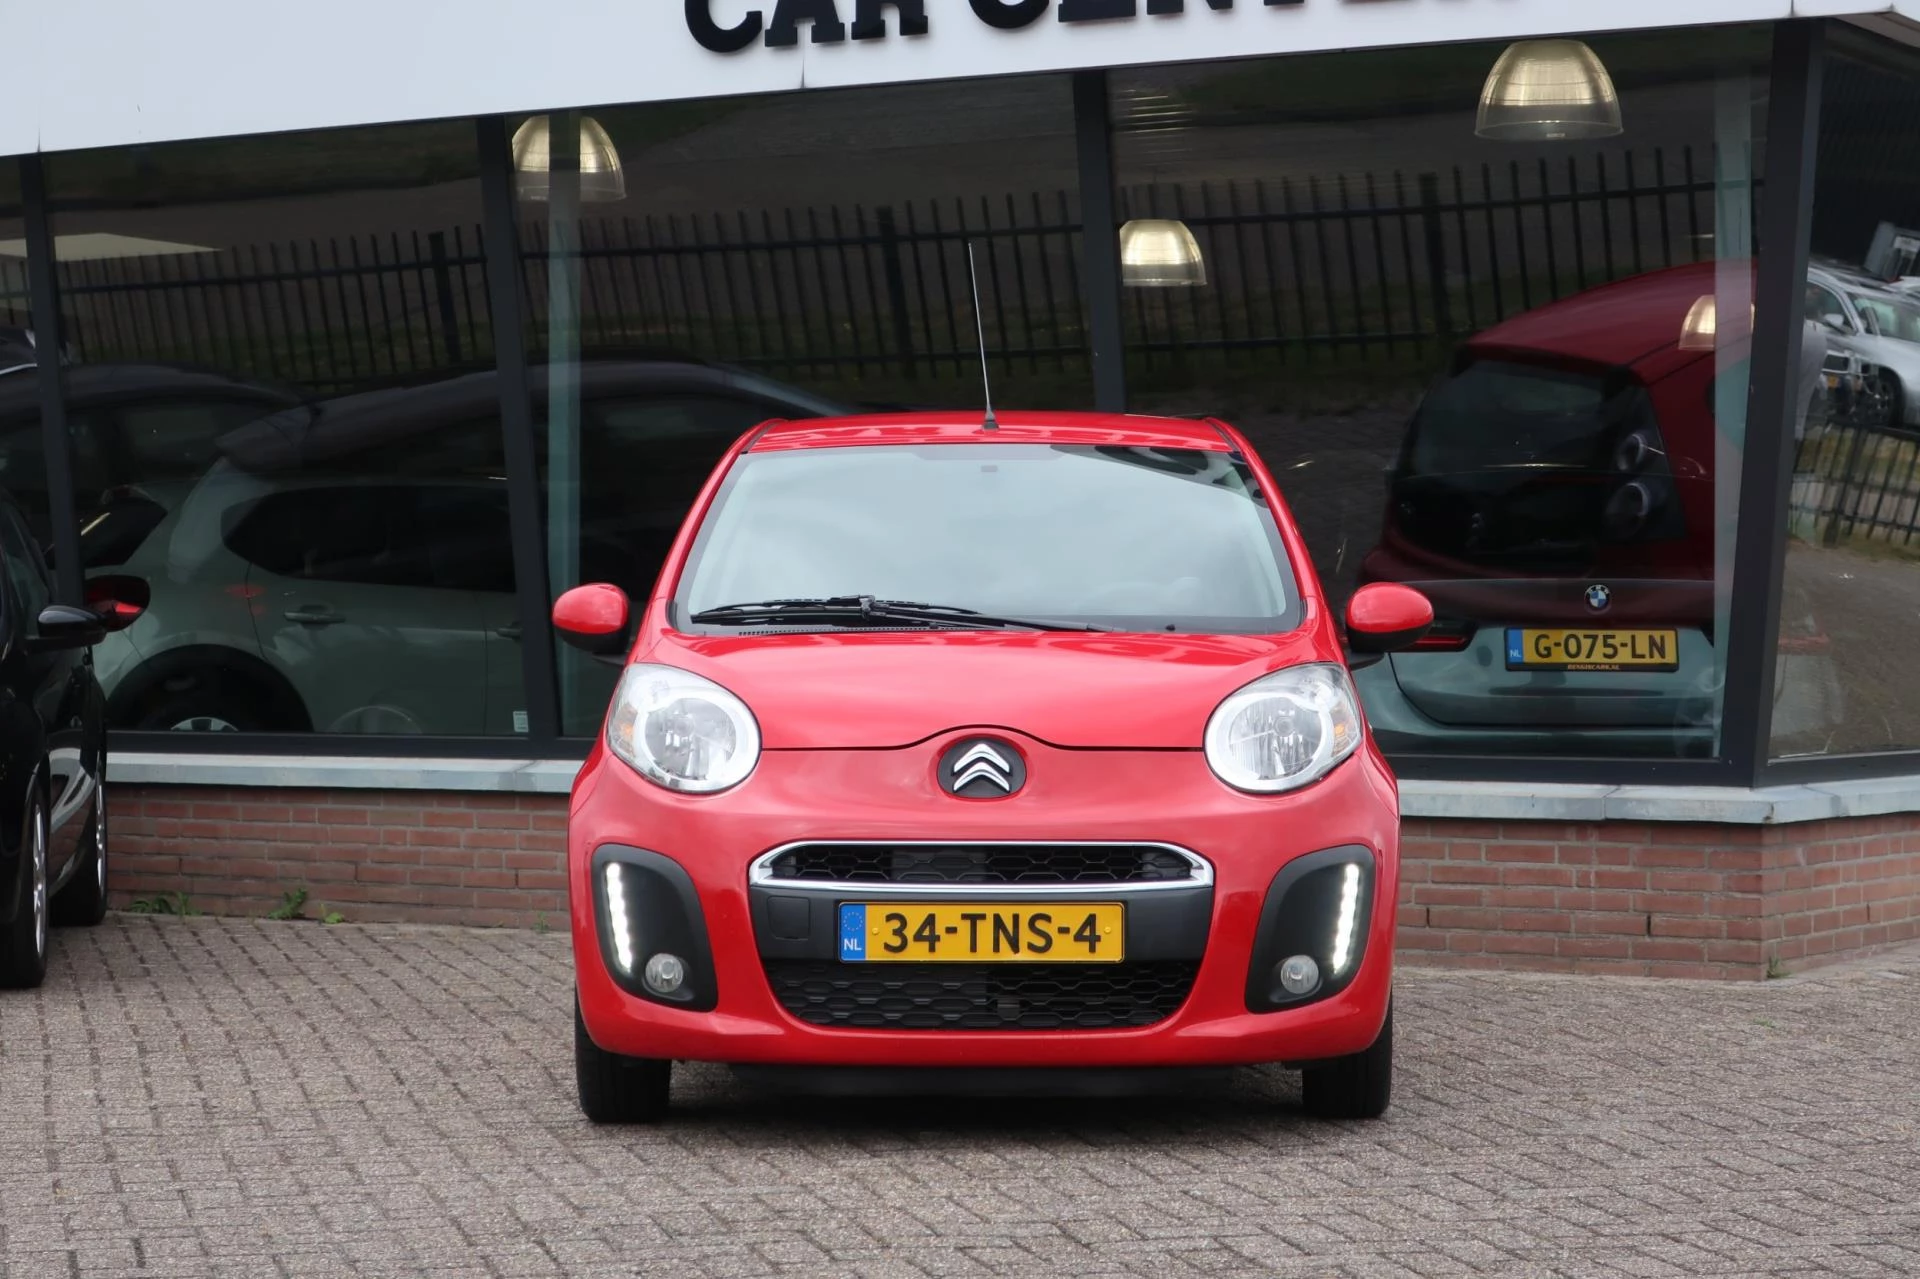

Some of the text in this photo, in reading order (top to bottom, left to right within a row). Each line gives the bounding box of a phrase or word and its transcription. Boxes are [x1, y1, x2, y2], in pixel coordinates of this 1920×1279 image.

[1510, 650, 1521, 658] NL
[1534, 634, 1667, 659] G-075-LN
[883, 913, 1101, 953] 34-TNS-4
[844, 938, 861, 951] NL
